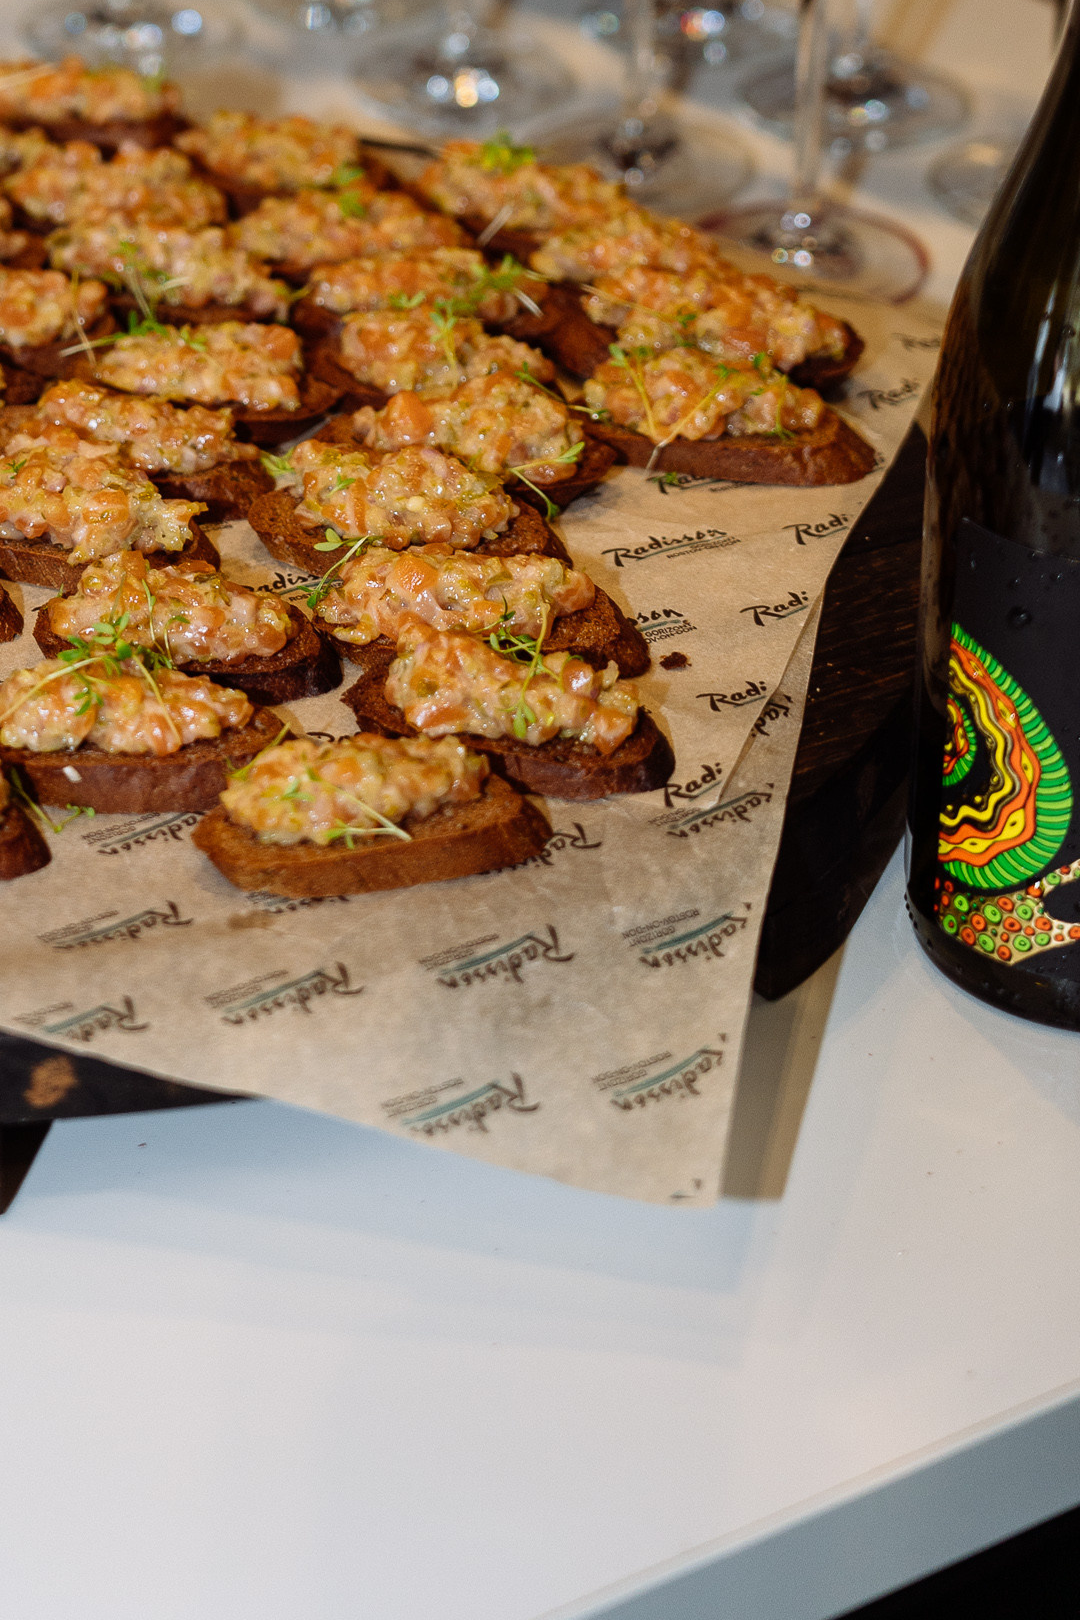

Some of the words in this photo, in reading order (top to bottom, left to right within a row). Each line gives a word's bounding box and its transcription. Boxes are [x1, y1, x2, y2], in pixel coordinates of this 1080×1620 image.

[782, 513, 849, 545] Radi
[601, 529, 727, 567] Radisson
[740, 591, 809, 627] Radi
[645, 621, 692, 638] GORIZONT
[645, 626, 697, 644] OV-ON-DON
[696, 681, 767, 712] Radi
[664, 762, 723, 808] Radi
[97, 811, 205, 855] adisson
[52, 900, 195, 951] Radisson
[621, 909, 701, 940] ROSTOV-ON-DON
[627, 925, 676, 948] GORIZONT
[436, 923, 576, 989] Radisson
[220, 960, 365, 1026] Radisson
